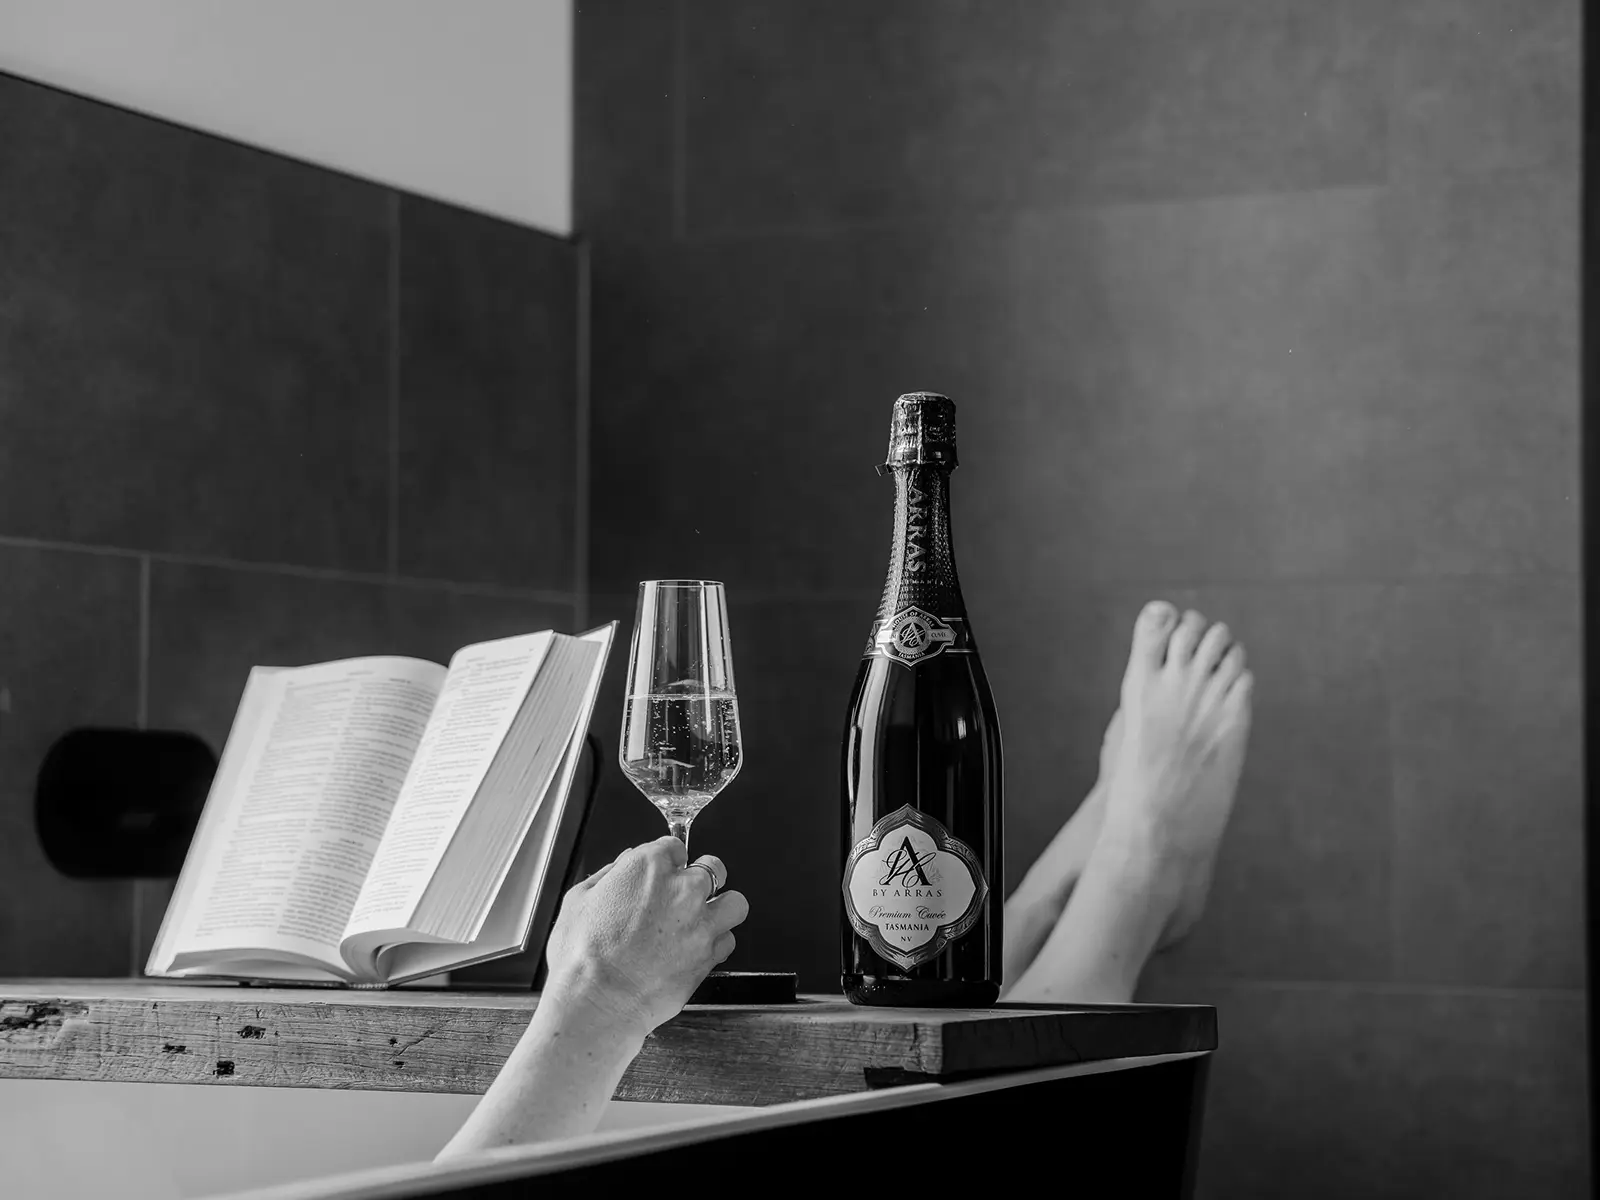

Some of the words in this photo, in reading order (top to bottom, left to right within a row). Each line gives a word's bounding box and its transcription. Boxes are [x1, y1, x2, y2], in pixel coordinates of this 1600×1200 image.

[872, 889, 888, 897] BY
[893, 889, 943, 897] ARRAS
[869, 905, 912, 919] Premium
[916, 905, 946, 919] Cuvée
[885, 923, 930, 931] TASMANIA
